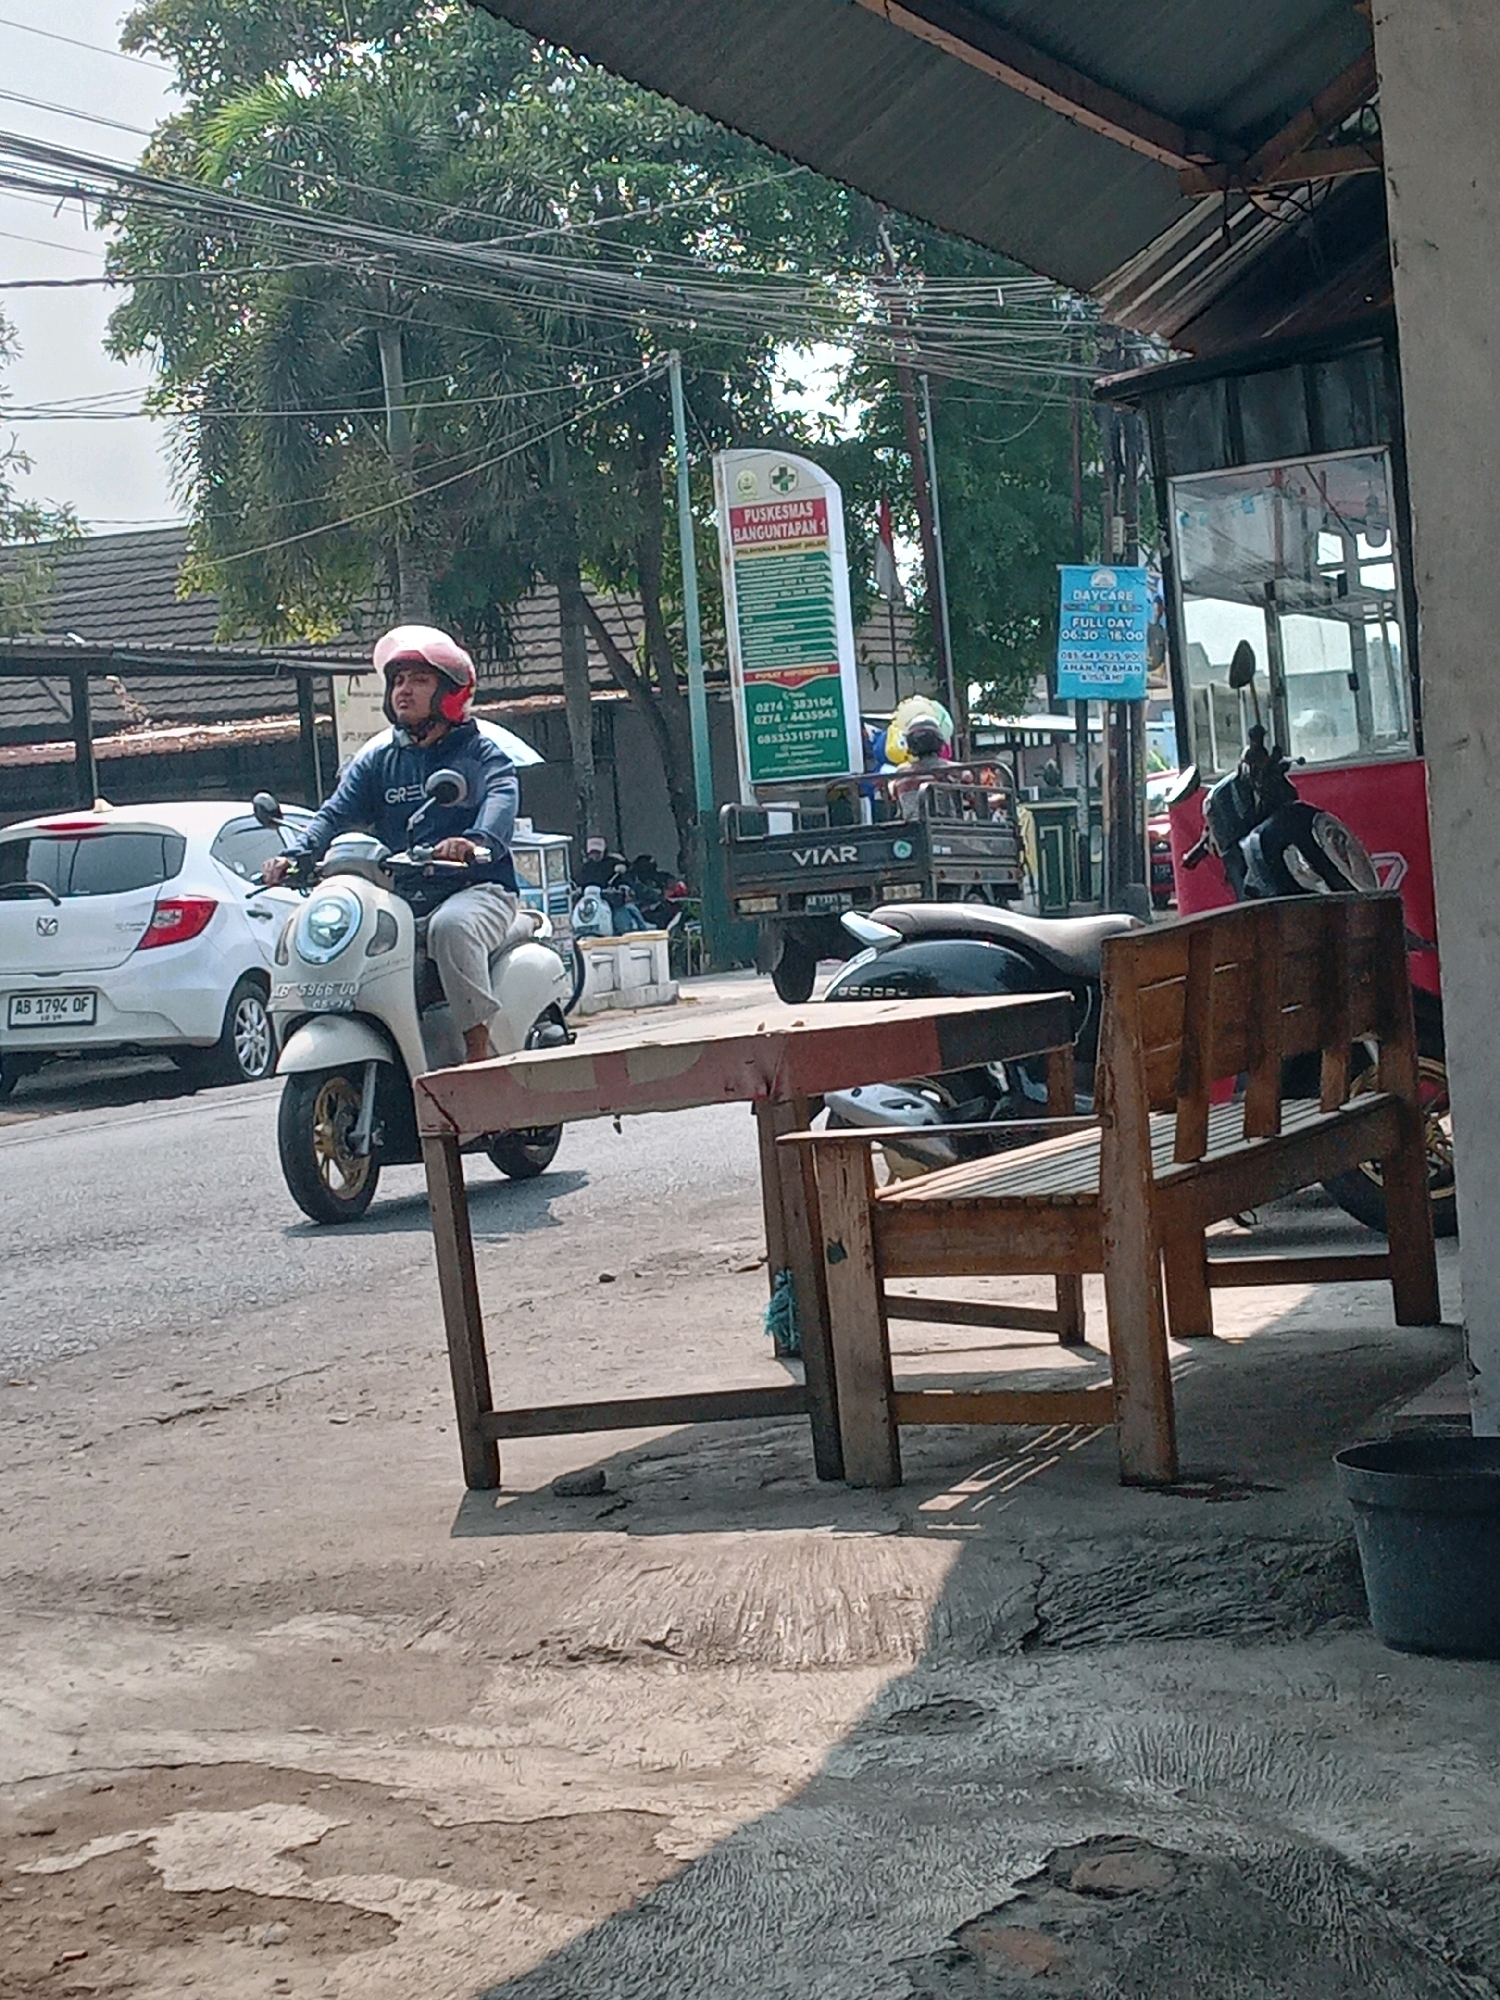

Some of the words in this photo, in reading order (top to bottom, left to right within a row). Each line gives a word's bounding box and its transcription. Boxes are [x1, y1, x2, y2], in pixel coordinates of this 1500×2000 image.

[744, 502, 814, 523] PUSKESMAS
[733, 520, 818, 542] BANGUNTAPAN
[820, 518, 827, 534] 1
[1073, 590, 1134, 601] DAYCARE
[1072, 617, 1104, 628] FULL
[1107, 617, 1134, 628] DAY
[1061, 630, 1099, 640] 06.30
[1109, 631, 1144, 641] 16.00
[755, 701, 783, 713] 0274
[753, 713, 781, 725] 0274
[792, 846, 858, 867] VIAR
[298, 982, 334, 996] 5966
[15, 999, 31, 1015] AB
[36, 998, 68, 1014] 1794
